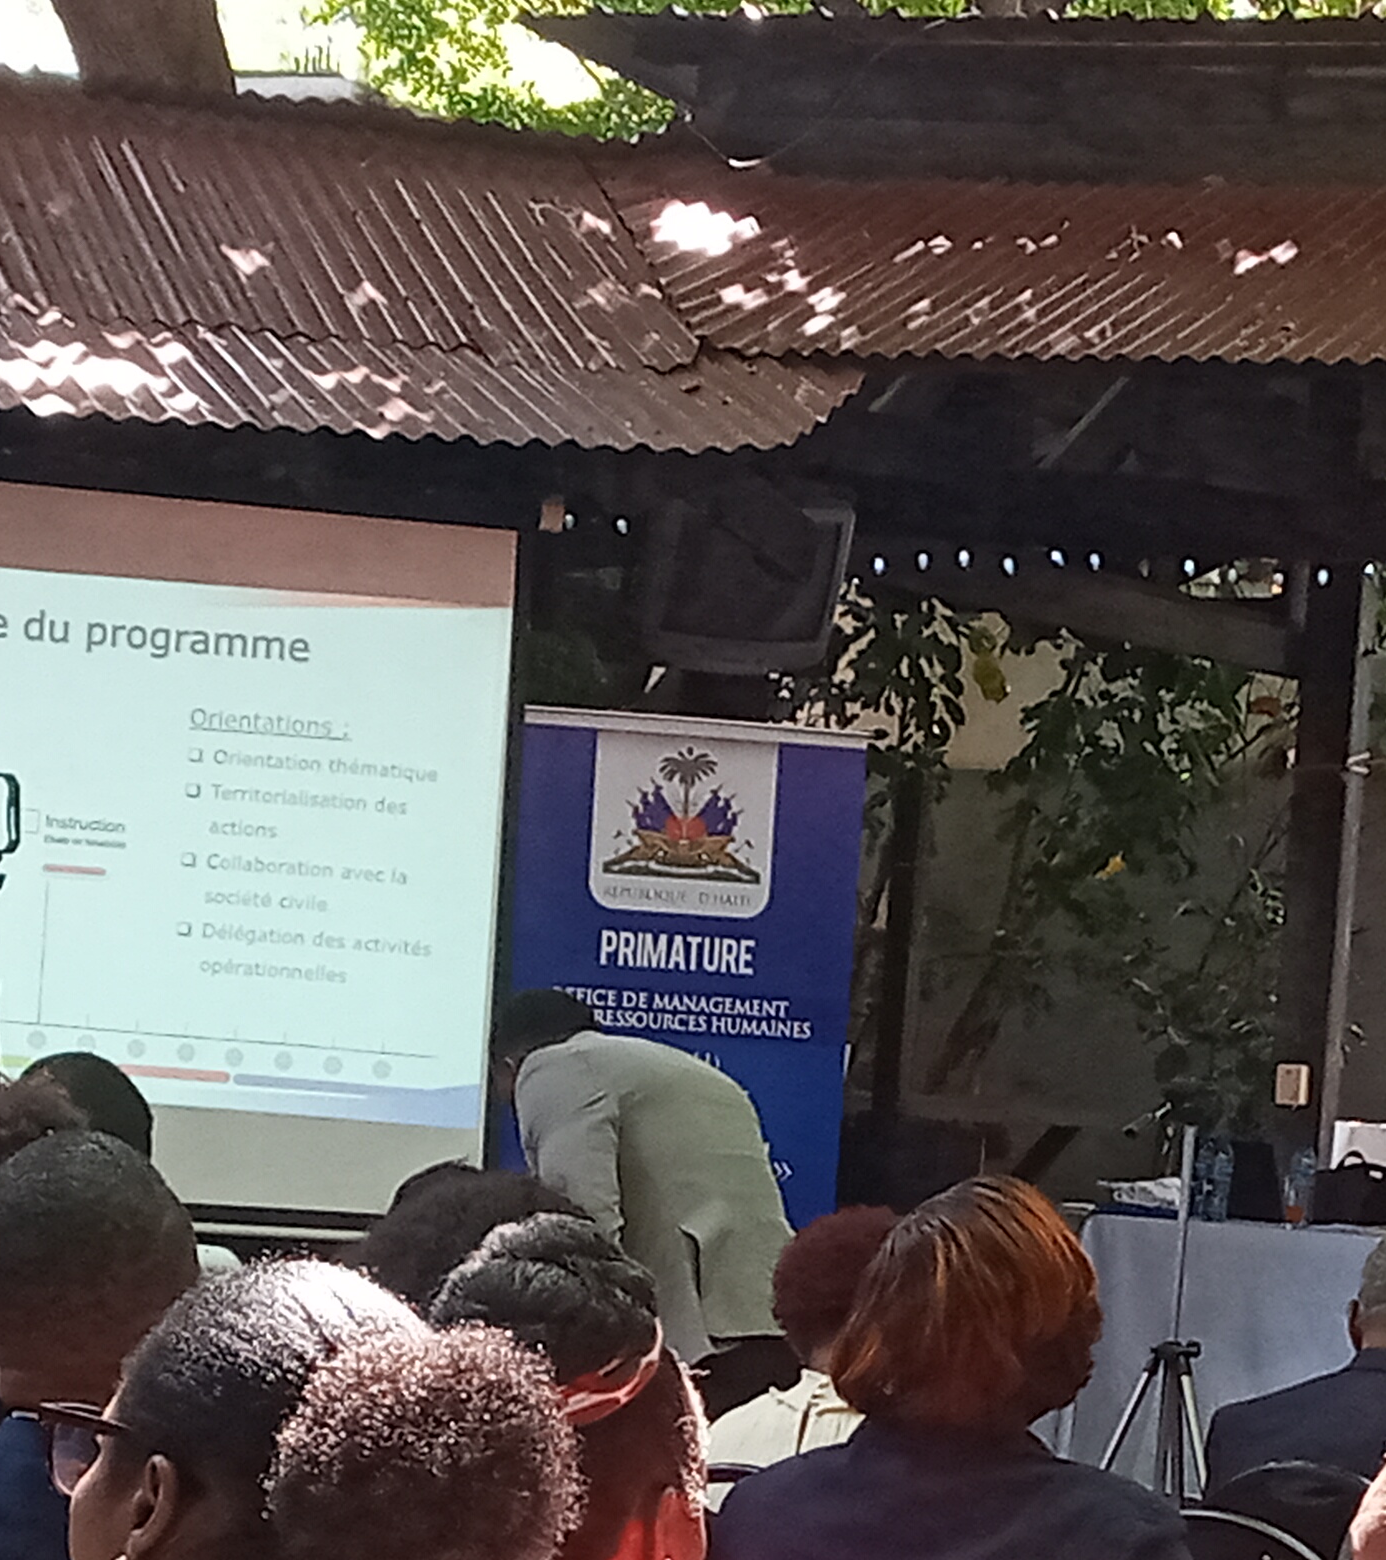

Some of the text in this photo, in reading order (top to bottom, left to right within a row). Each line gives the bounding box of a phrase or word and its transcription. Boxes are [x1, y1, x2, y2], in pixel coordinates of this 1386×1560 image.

[23, 609, 71, 643] du
[86, 621, 311, 663] programme
[189, 707, 333, 738] Orientations
[212, 748, 439, 784] Orientation thématique
[211, 782, 408, 816] Territorialisation des
[45, 814, 126, 833] Instruction
[208, 818, 278, 839] actions
[206, 852, 408, 886] Collaboration avec la
[204, 888, 329, 913] société civile
[201, 922, 433, 957] Délégation des activités
[599, 929, 757, 976] PRIMATURE
[198, 958, 348, 985] opérationnelles
[622, 990, 649, 1009] DE
[653, 993, 790, 1018] MANAGEMENT
[593, 1008, 812, 1040] RESSOURCES HUMAINES
